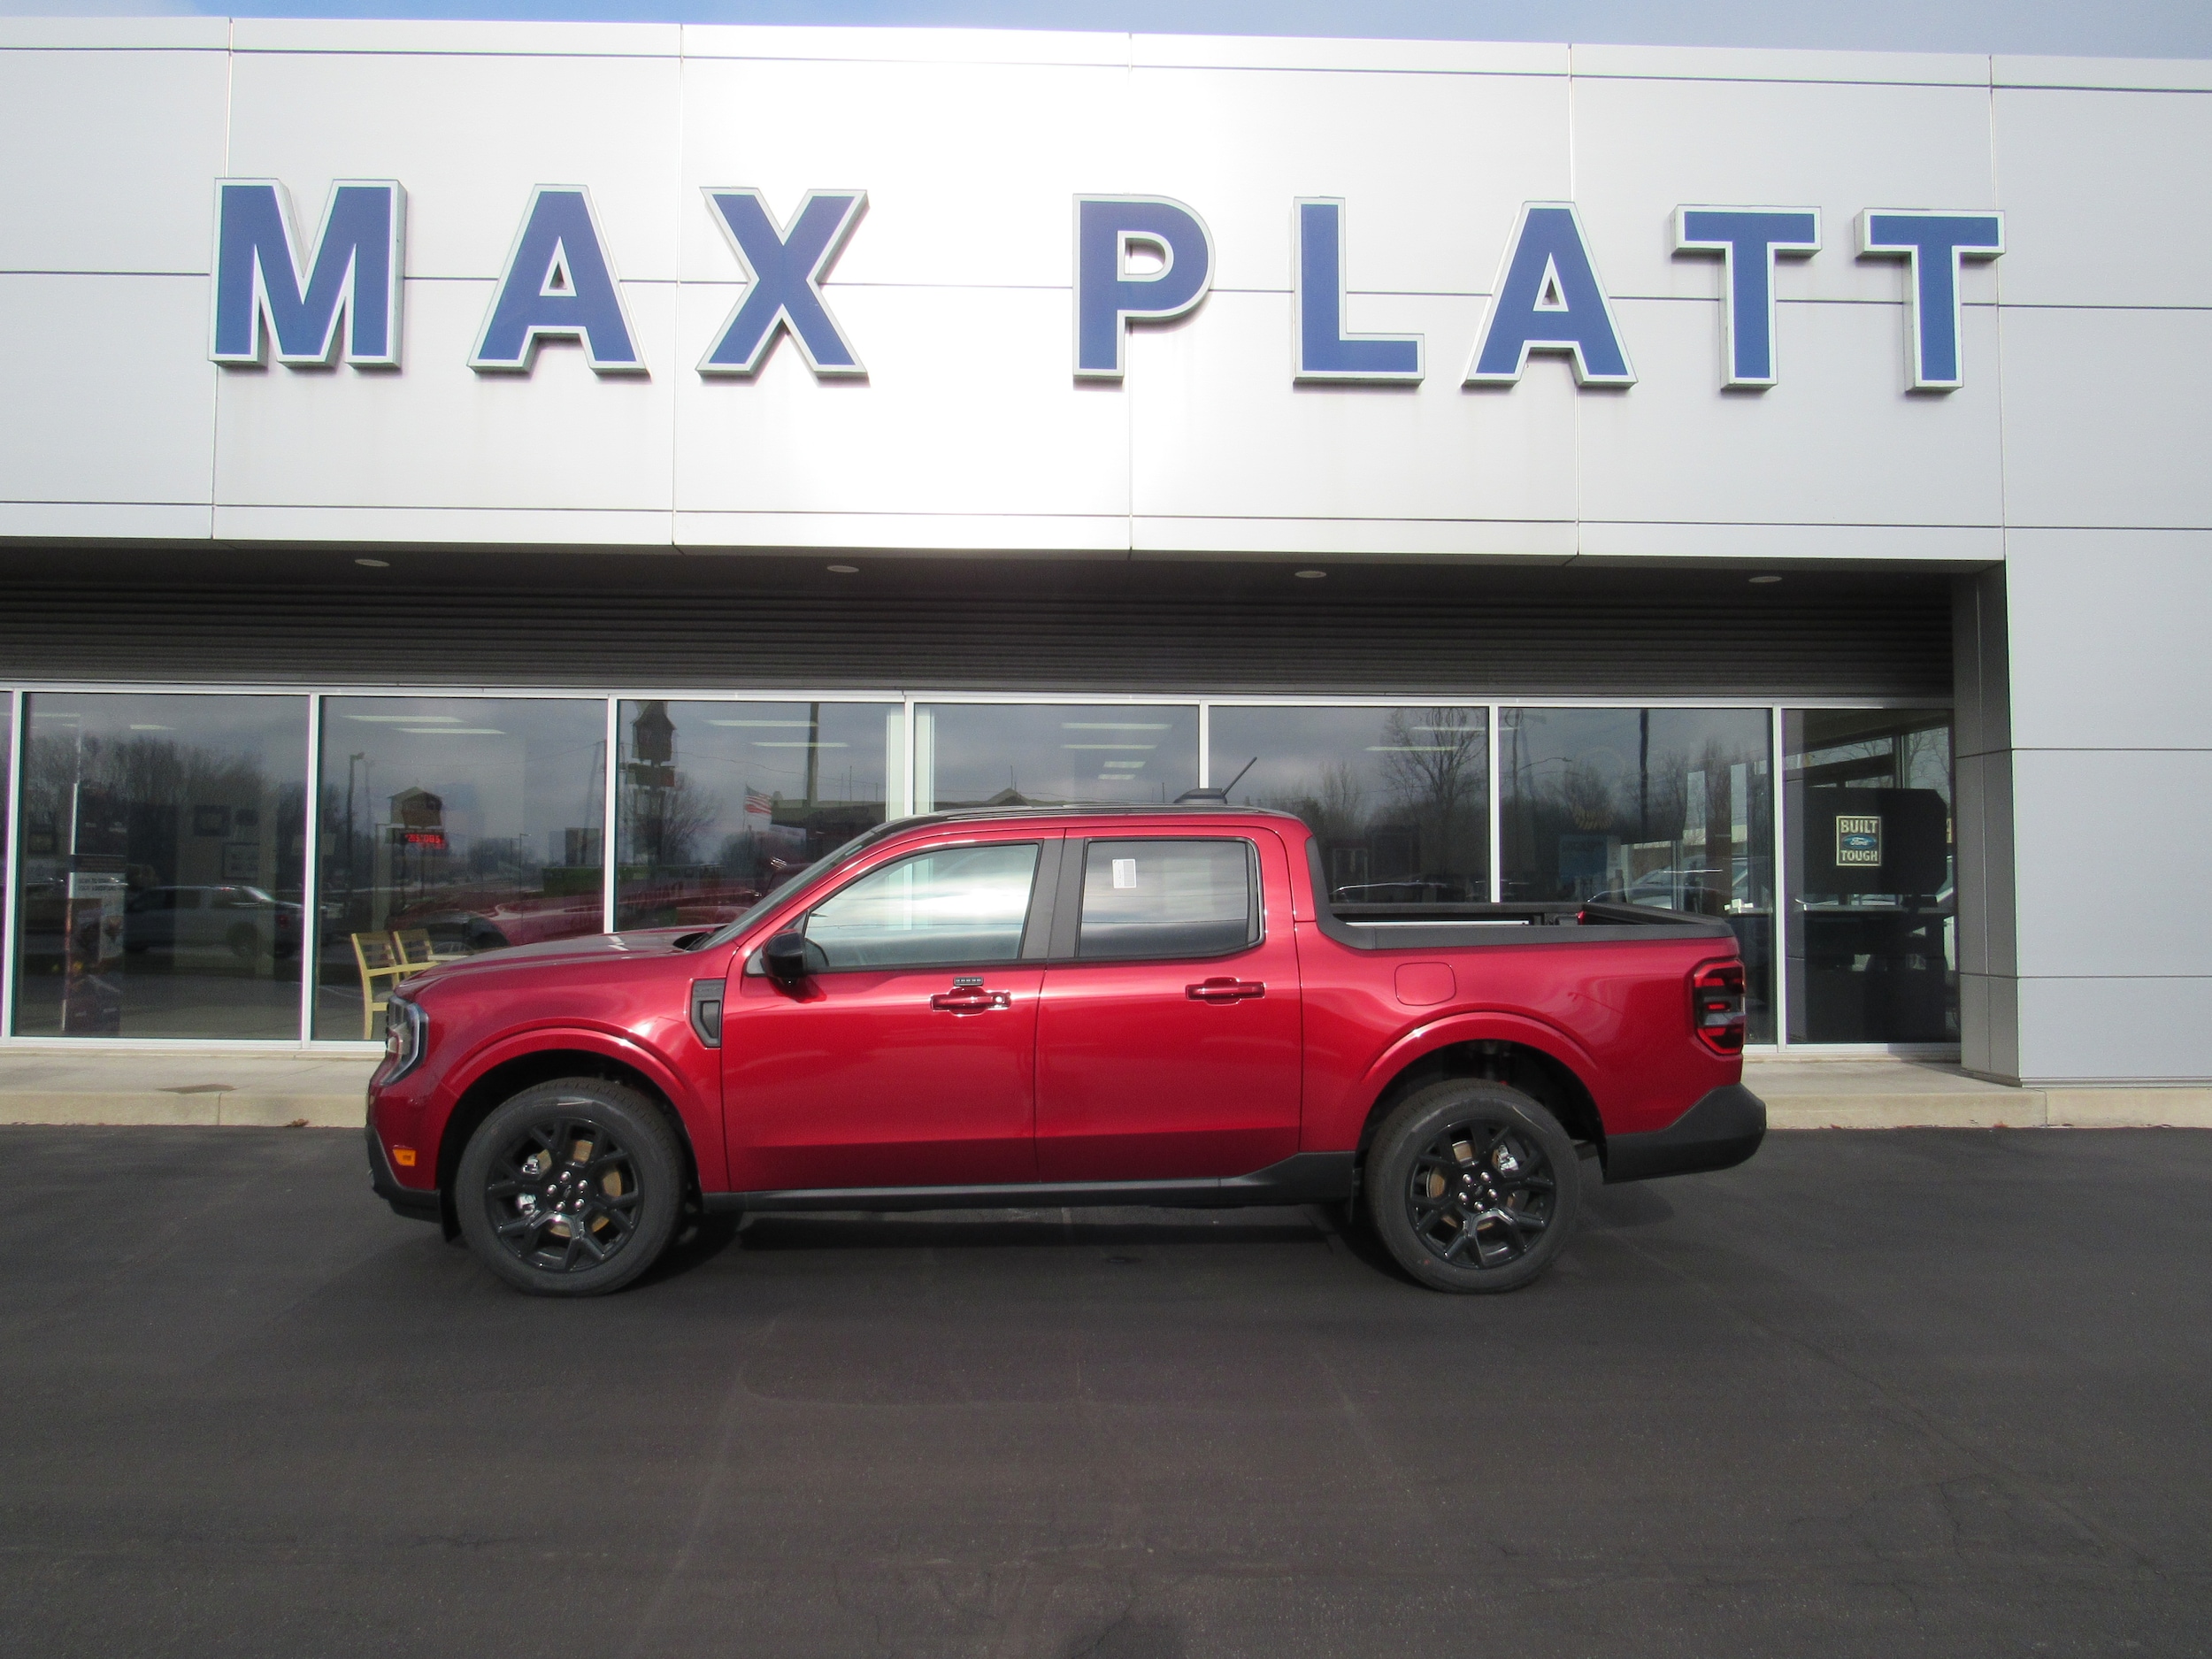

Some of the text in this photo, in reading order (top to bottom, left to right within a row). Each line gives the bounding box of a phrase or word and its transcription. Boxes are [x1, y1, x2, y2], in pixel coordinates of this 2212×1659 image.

[210, 178, 2006, 395] MAX PLATT
[1840, 819, 1878, 833] BUILT
[1849, 836, 1870, 846] Ford
[1840, 850, 1878, 862] TOUGH
